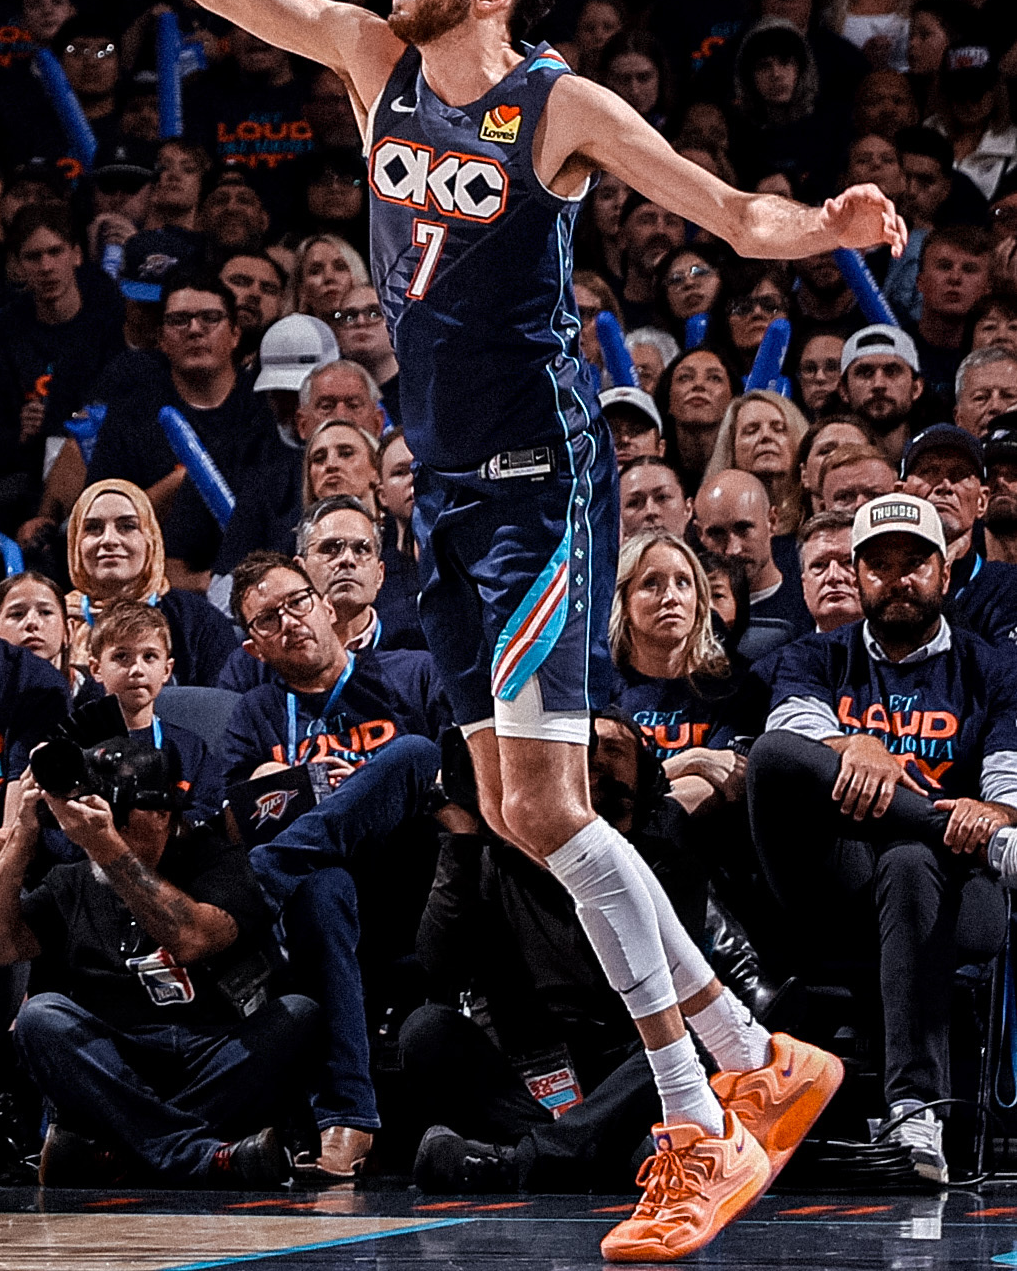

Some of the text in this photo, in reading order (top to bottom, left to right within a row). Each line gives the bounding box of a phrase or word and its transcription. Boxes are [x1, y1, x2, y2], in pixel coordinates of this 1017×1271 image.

[216, 120, 314, 142] LOUD
[482, 126, 514, 142] Love's
[369, 136, 509, 224] OKC
[406, 218, 448, 301] 7
[871, 503, 920, 522] THUNDER
[882, 694, 918, 714] ET
[632, 709, 684, 727] GET
